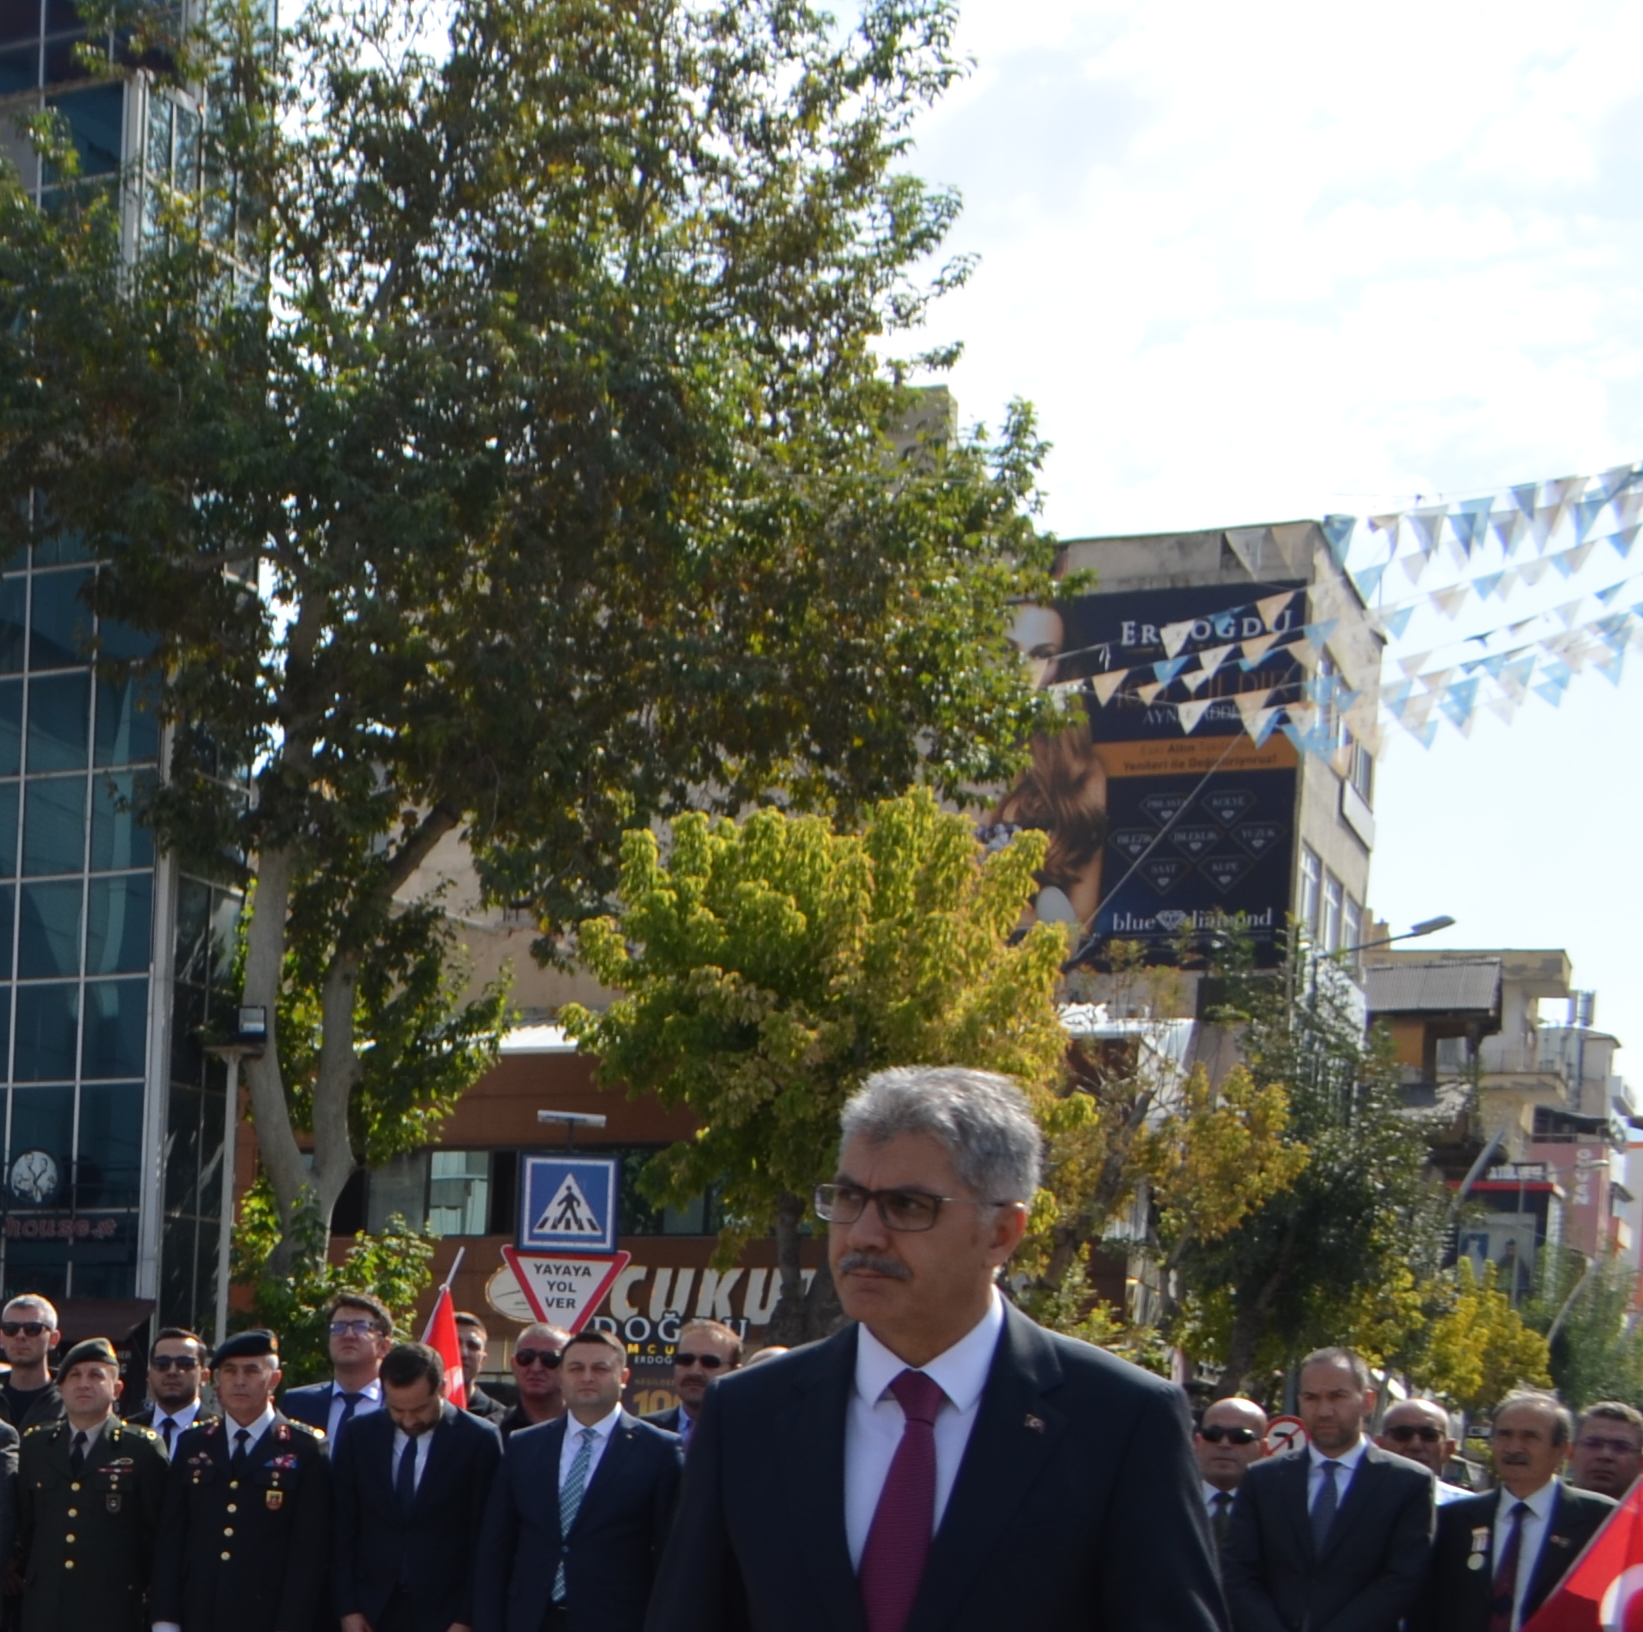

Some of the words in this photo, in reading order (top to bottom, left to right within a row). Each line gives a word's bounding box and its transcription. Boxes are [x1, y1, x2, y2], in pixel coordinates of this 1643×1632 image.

[1112, 911, 1157, 932] blue
[534, 1262, 592, 1278] YAYAYA
[547, 1279, 577, 1293] YOL
[544, 1296, 577, 1310] VER
